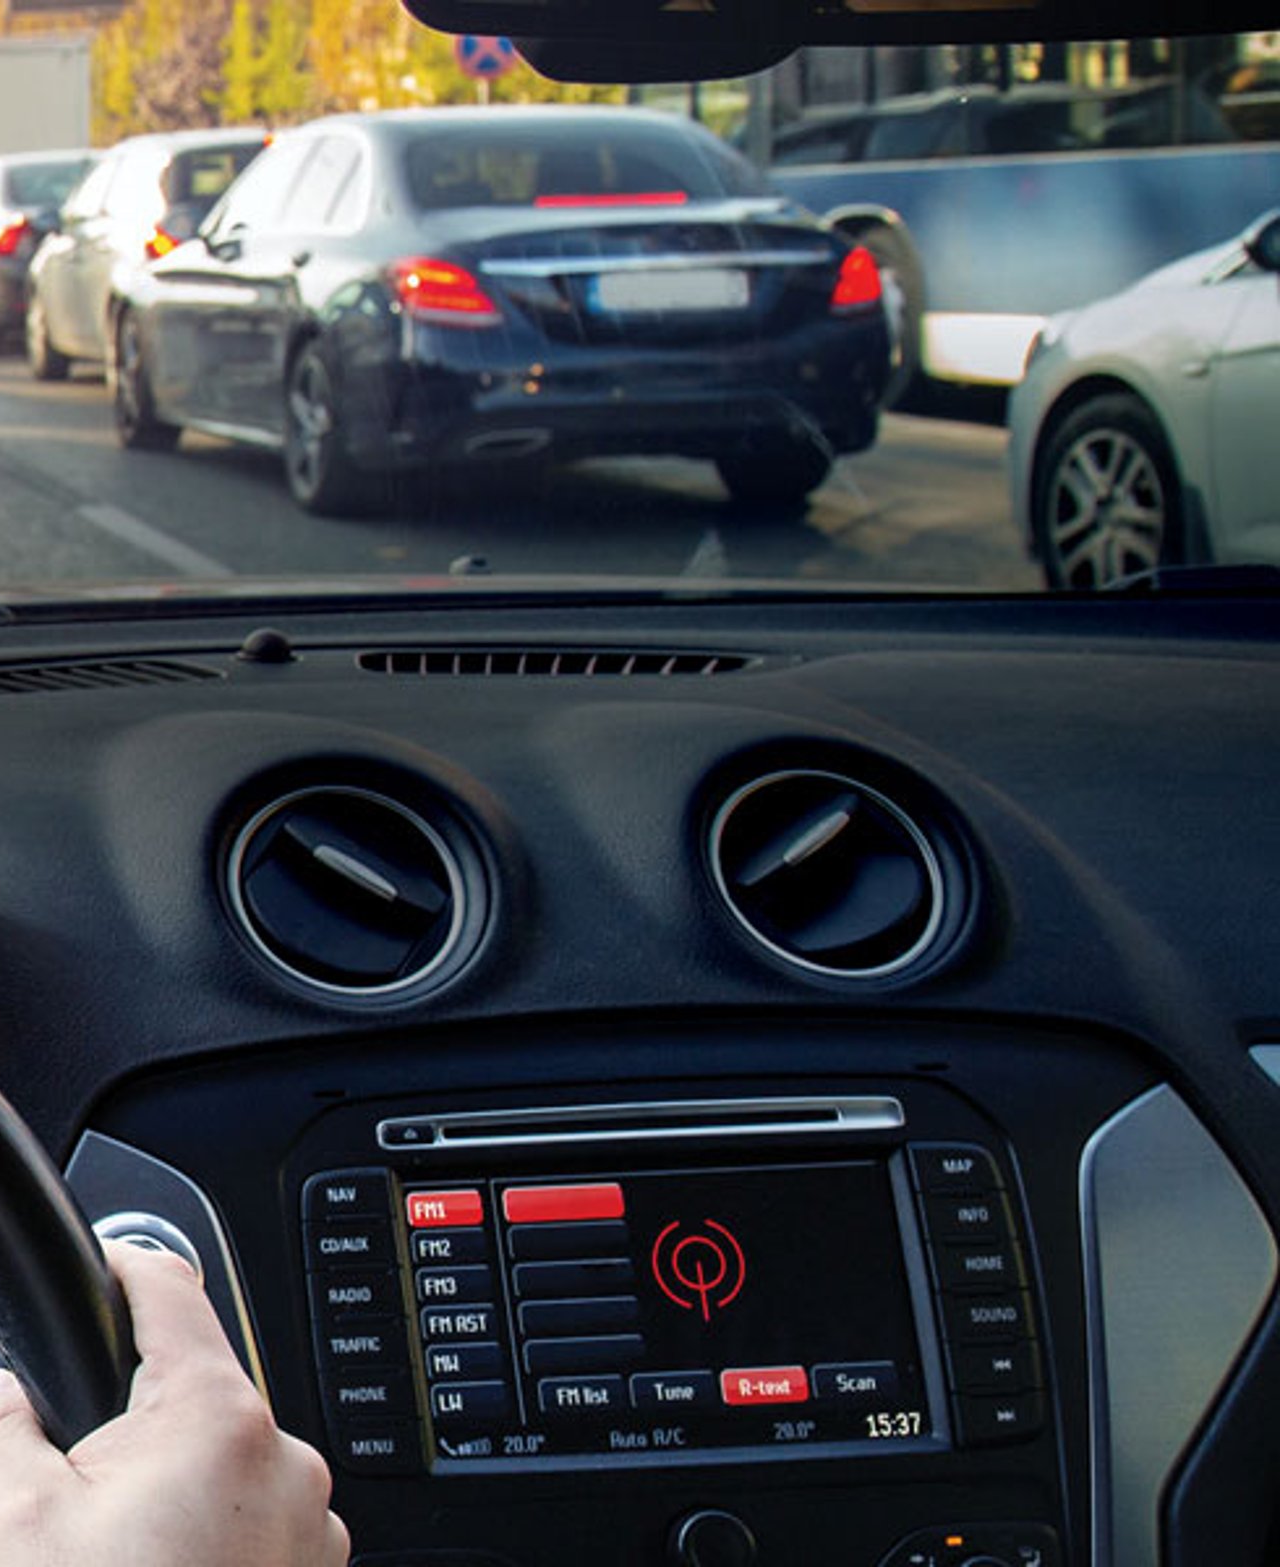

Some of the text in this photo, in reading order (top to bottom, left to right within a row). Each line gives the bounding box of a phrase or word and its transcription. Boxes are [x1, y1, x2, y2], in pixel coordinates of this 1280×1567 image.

[942, 1159, 973, 1174] MAP
[326, 1187, 356, 1202] NAV
[414, 1201, 446, 1220] FM1
[957, 1208, 989, 1222] INFO
[320, 1237, 369, 1253] CD/AUX
[419, 1238, 452, 1257] FM2
[965, 1256, 1004, 1271] HOME
[328, 1286, 372, 1303] RADIO
[424, 1276, 457, 1296] FM3
[429, 1312, 488, 1334] FM RST
[970, 1307, 1017, 1323] SOUND
[330, 1335, 382, 1354] TRAFFIC
[433, 1353, 460, 1373] MW
[653, 1383, 694, 1401] Tune
[738, 1377, 791, 1397] R-text
[835, 1373, 877, 1393] Scan
[338, 1386, 387, 1403] PHONE
[439, 1393, 463, 1412] LW
[556, 1386, 610, 1406] FM list
[865, 1411, 921, 1438] 15:37
[351, 1440, 394, 1456] MENU
[610, 1430, 648, 1448] Auto
